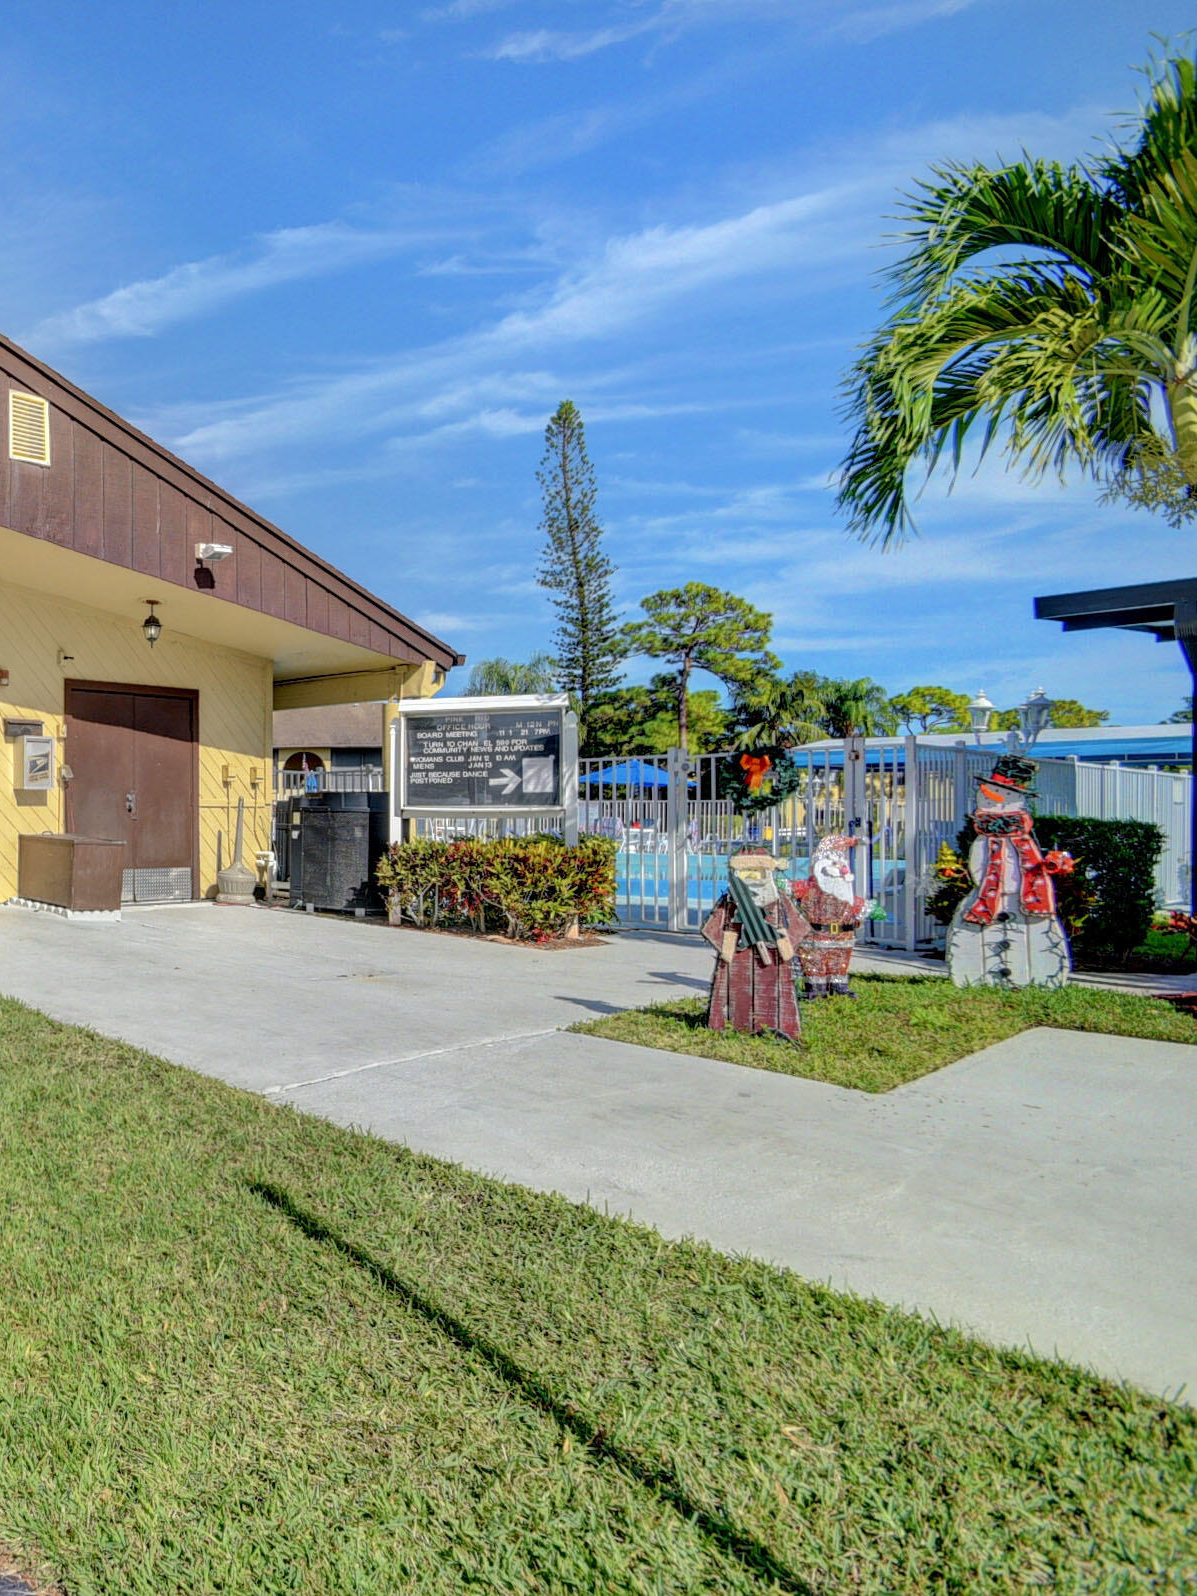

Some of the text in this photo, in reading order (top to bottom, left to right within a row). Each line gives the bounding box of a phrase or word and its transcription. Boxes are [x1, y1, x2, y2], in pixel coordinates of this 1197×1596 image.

[436, 723, 467, 731] OFFICE
[468, 722, 491, 730] HOUR
[445, 730, 478, 738] MEETING
[423, 740, 444, 748] TURN
[511, 738, 528, 746] FOR
[423, 746, 468, 754] COMMUNITY
[510, 744, 545, 752] UPDATES
[462, 770, 489, 778] DANCE
[410, 777, 453, 785] POSTPONED
